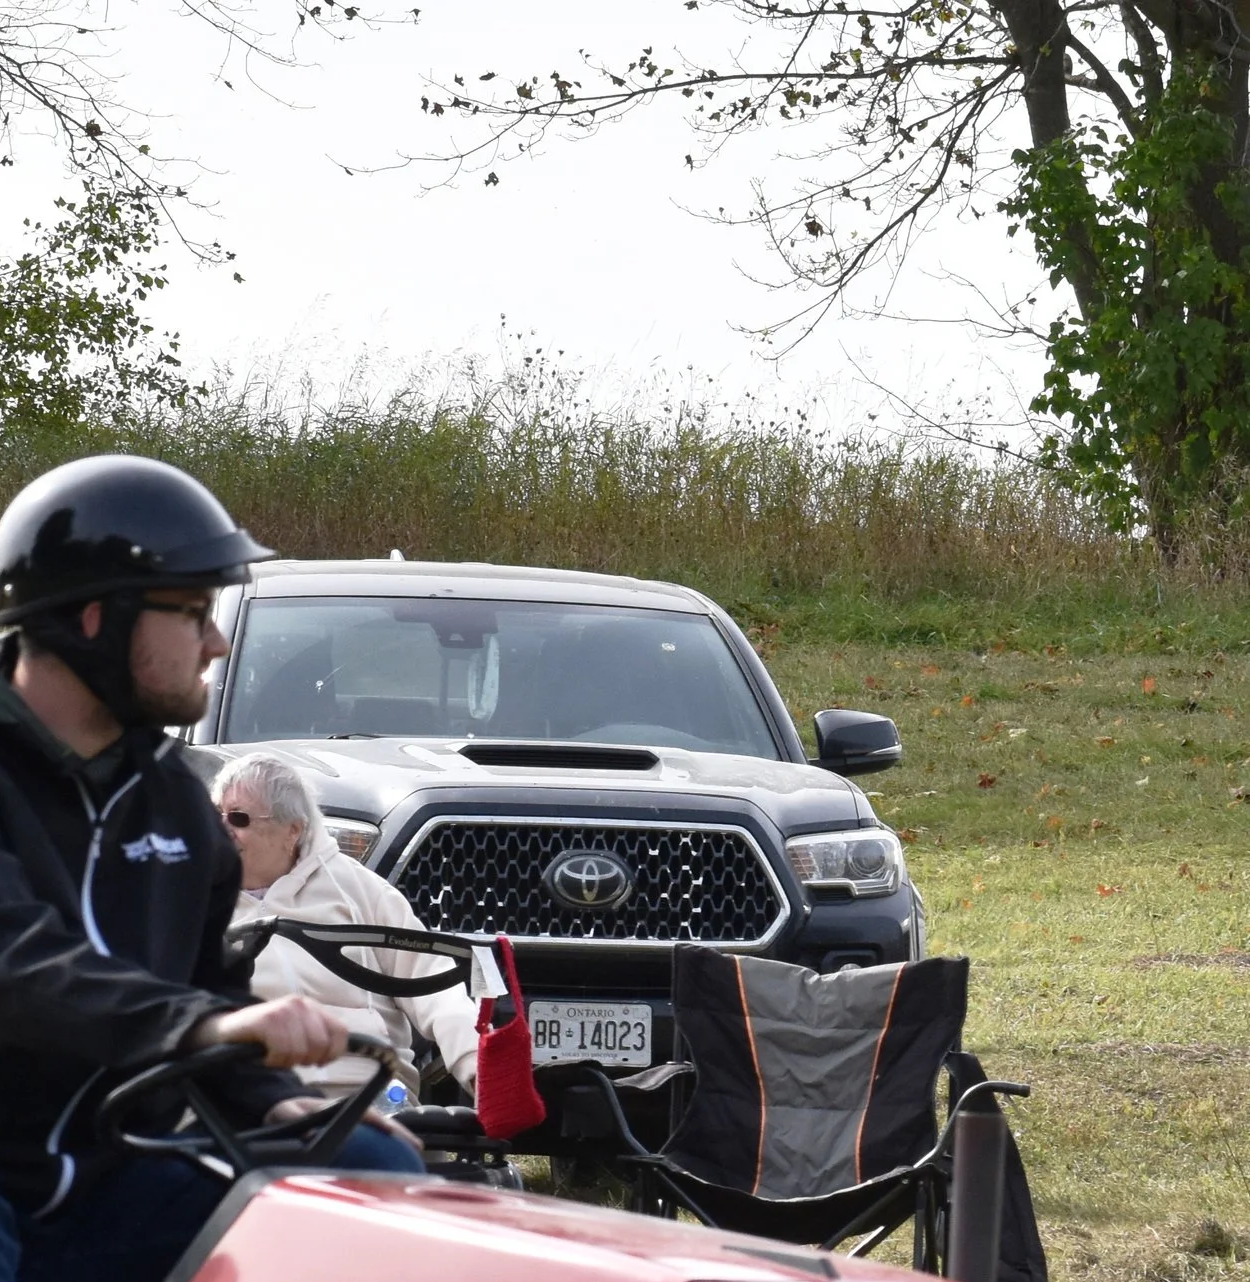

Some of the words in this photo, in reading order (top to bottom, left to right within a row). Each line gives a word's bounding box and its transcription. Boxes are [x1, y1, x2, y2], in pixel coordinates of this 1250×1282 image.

[388, 934, 430, 949] Evolution
[566, 1007, 615, 1018] ONTARIO
[534, 1019, 561, 1049] BB
[578, 1020, 646, 1051] 14023
